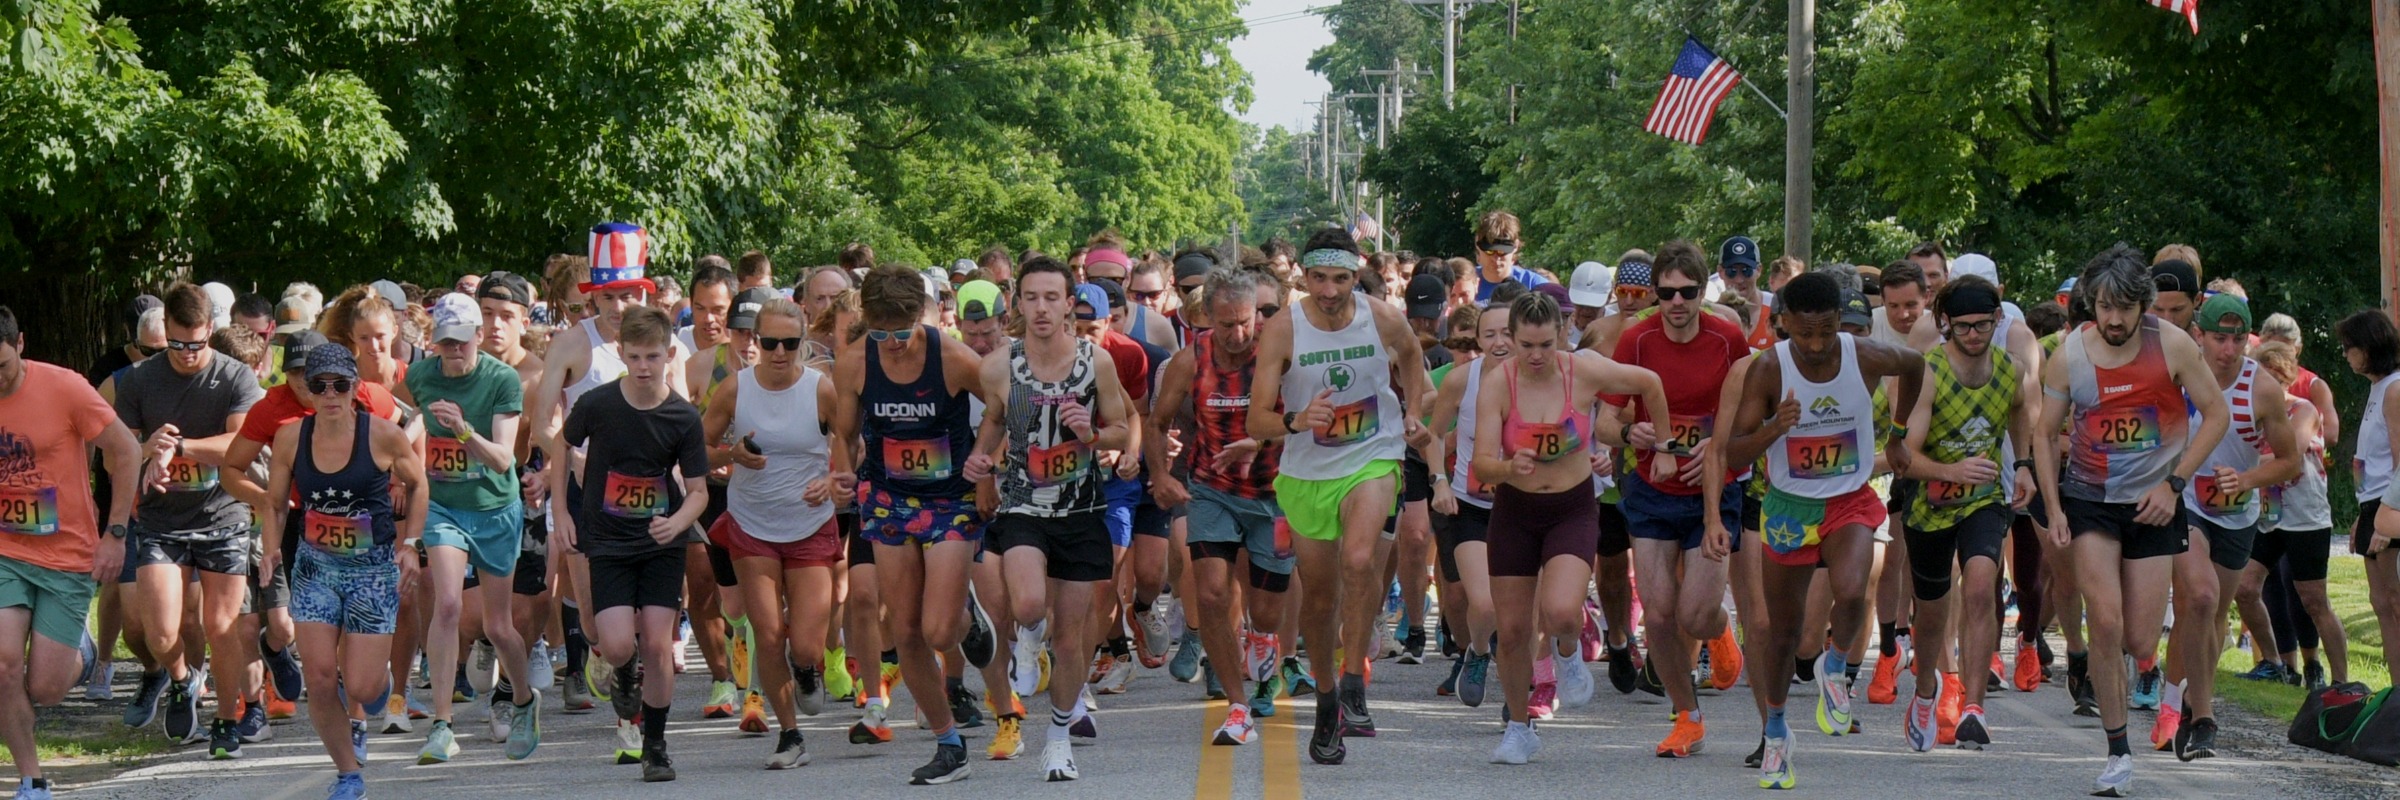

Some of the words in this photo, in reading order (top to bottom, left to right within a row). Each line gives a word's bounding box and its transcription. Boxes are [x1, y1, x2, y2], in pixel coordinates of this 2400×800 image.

[1299, 350, 1341, 367] SOUTH
[1343, 344, 1375, 361] HERO
[2109, 384, 2133, 394] BANDIT
[874, 402, 936, 417] UCONN
[1326, 410, 1365, 438] 217
[1796, 422, 1819, 430] GREEN
[1820, 416, 1855, 425] MOUNTAIN
[2100, 417, 2143, 444] 262
[1533, 433, 1559, 455] 78
[1670, 424, 1700, 448] 26
[431, 447, 468, 472] 259
[901, 449, 930, 471] 84
[1041, 451, 1078, 478] 183
[1800, 443, 1842, 470] 347
[167, 462, 204, 483] 281
[615, 484, 656, 509] 256
[1, 499, 40, 525] 291
[316, 524, 357, 549] 255
